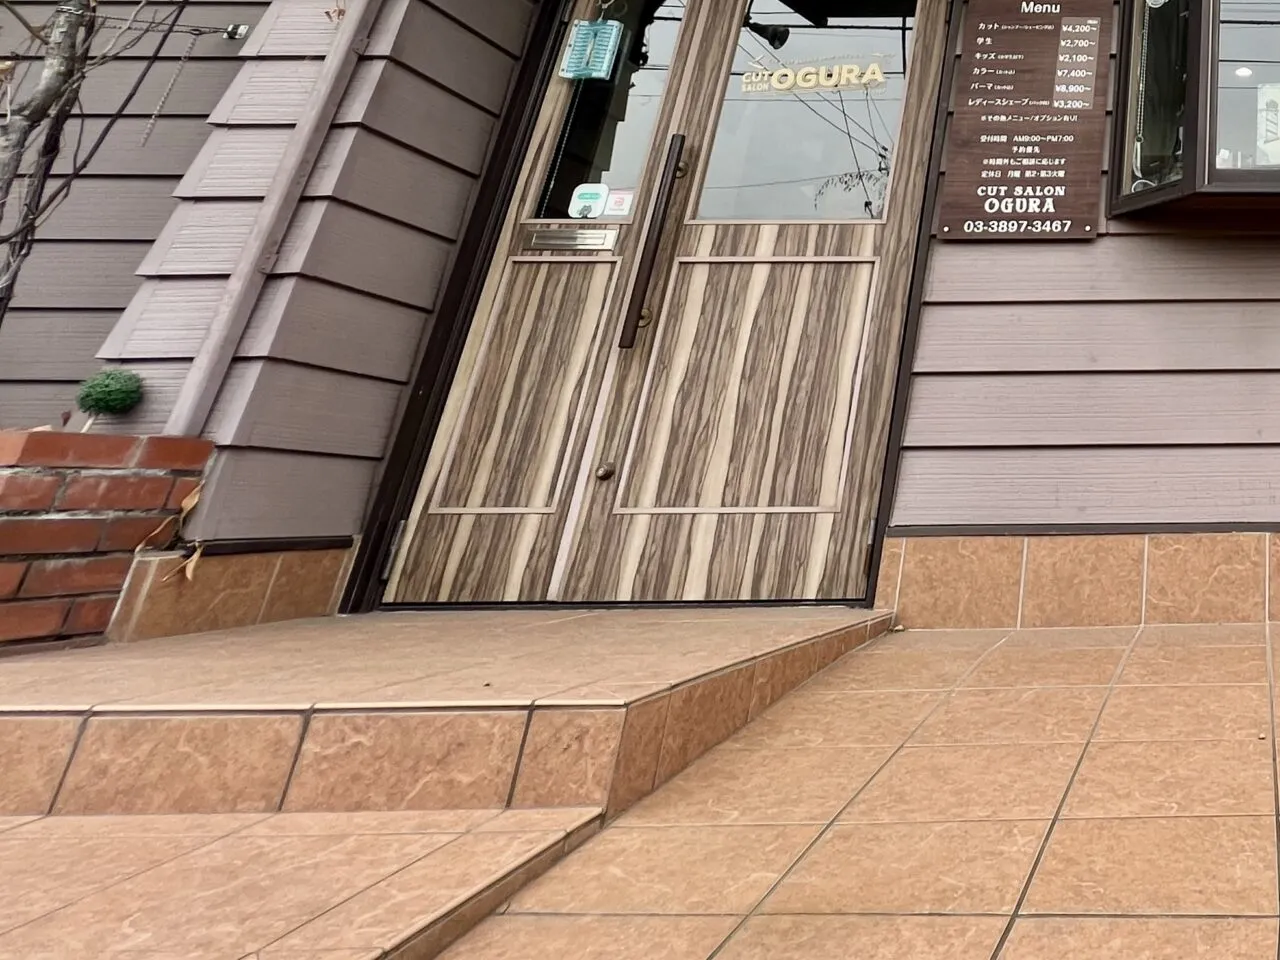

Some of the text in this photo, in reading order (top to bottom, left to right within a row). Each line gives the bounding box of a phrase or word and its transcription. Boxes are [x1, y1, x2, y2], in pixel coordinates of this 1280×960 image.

[1021, 1, 1060, 13] Menu
[978, 22, 1000, 30] カット
[976, 37, 993, 45] 学生
[974, 52, 996, 60] キッズ
[972, 67, 995, 75] カラー
[742, 62, 886, 90] CUT OGURA
[742, 83, 769, 91] SALON
[970, 82, 994, 90] パーマ
[981, 170, 1001, 178] 定休日
[1007, 170, 1021, 178] 月曜
[977, 186, 1066, 196] CUT SALON
[984, 197, 1055, 213] OGURA
[964, 220, 1072, 233] 03-3897-3467
